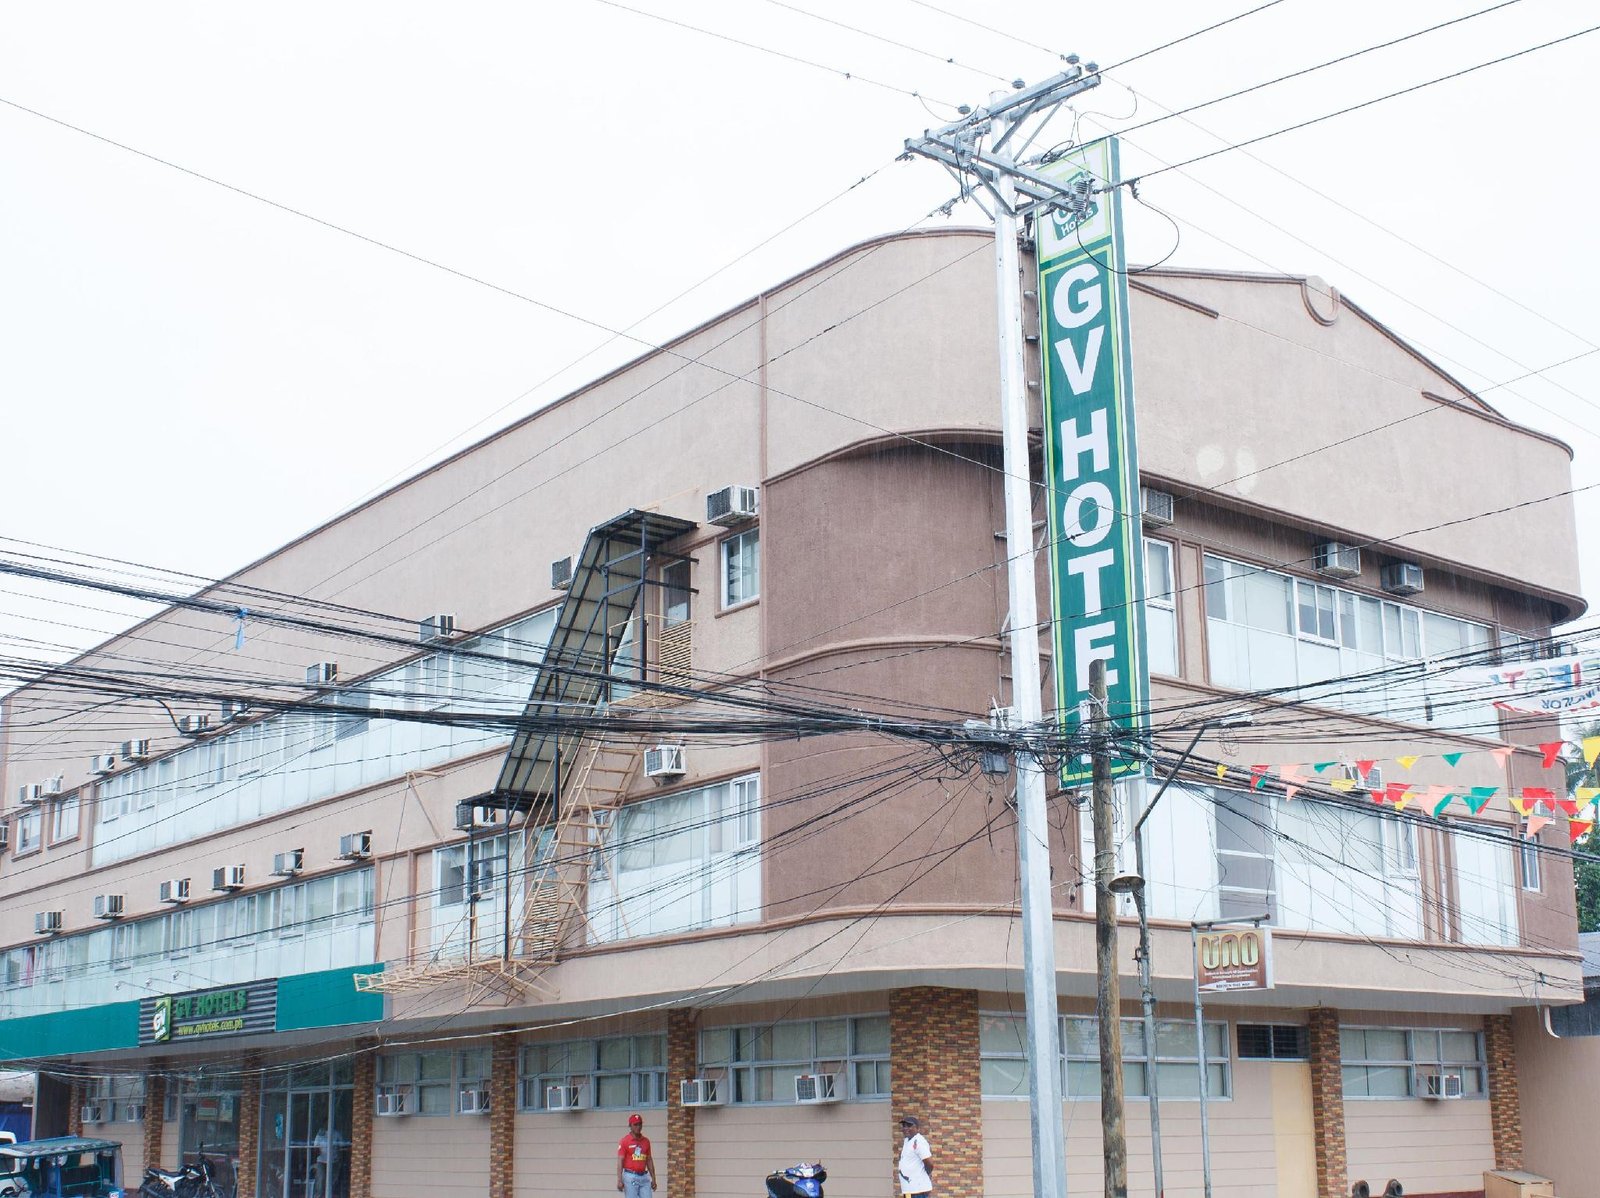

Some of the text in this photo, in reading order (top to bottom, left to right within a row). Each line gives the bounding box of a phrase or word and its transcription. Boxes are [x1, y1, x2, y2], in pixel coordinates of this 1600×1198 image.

[1053, 263, 1105, 396] GV
[175, 989, 247, 1019] GV HOTELS
